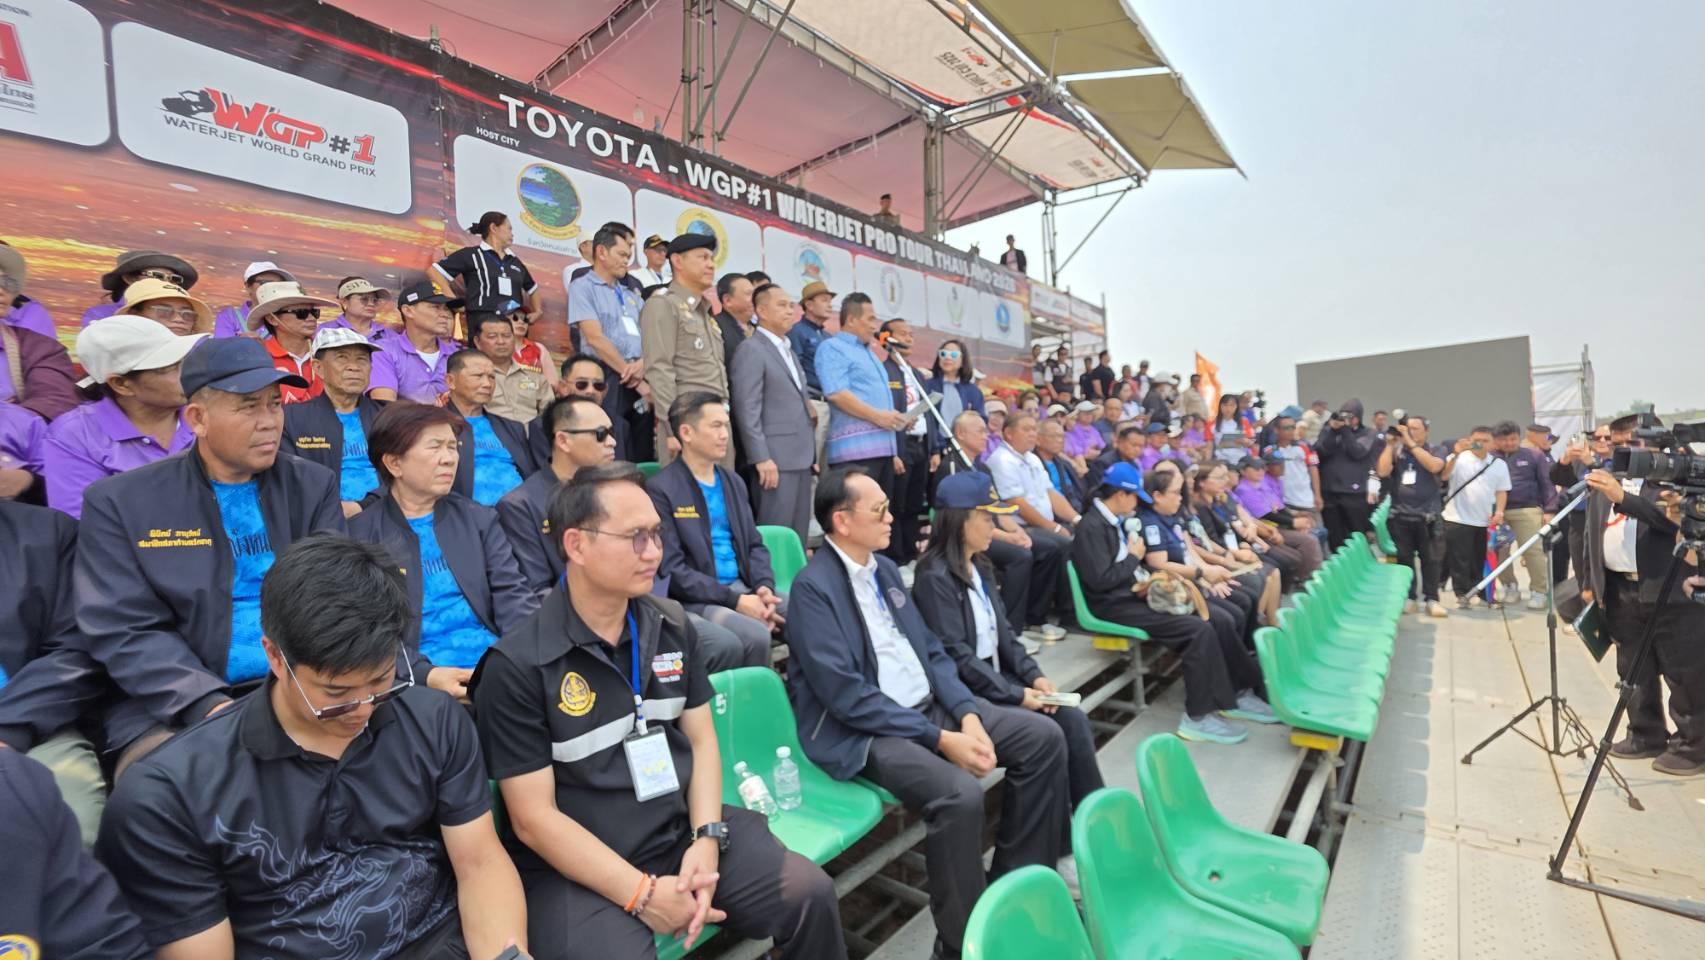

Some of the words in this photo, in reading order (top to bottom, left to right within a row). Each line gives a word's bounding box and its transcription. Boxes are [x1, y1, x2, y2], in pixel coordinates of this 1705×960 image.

[164, 115, 246, 144] WATERJET
[251, 137, 300, 159] WORLD
[303, 153, 347, 171] GRAND
[350, 163, 377, 178] PRIX
[476, 126, 500, 141] HOST
[500, 135, 521, 148] CITY
[499, 93, 660, 174] TOYOTA
[684, 158, 773, 211] WGP#1
[776, 191, 863, 244] WATERJET
[864, 224, 898, 256] PRO
[897, 235, 934, 268] TOUR
